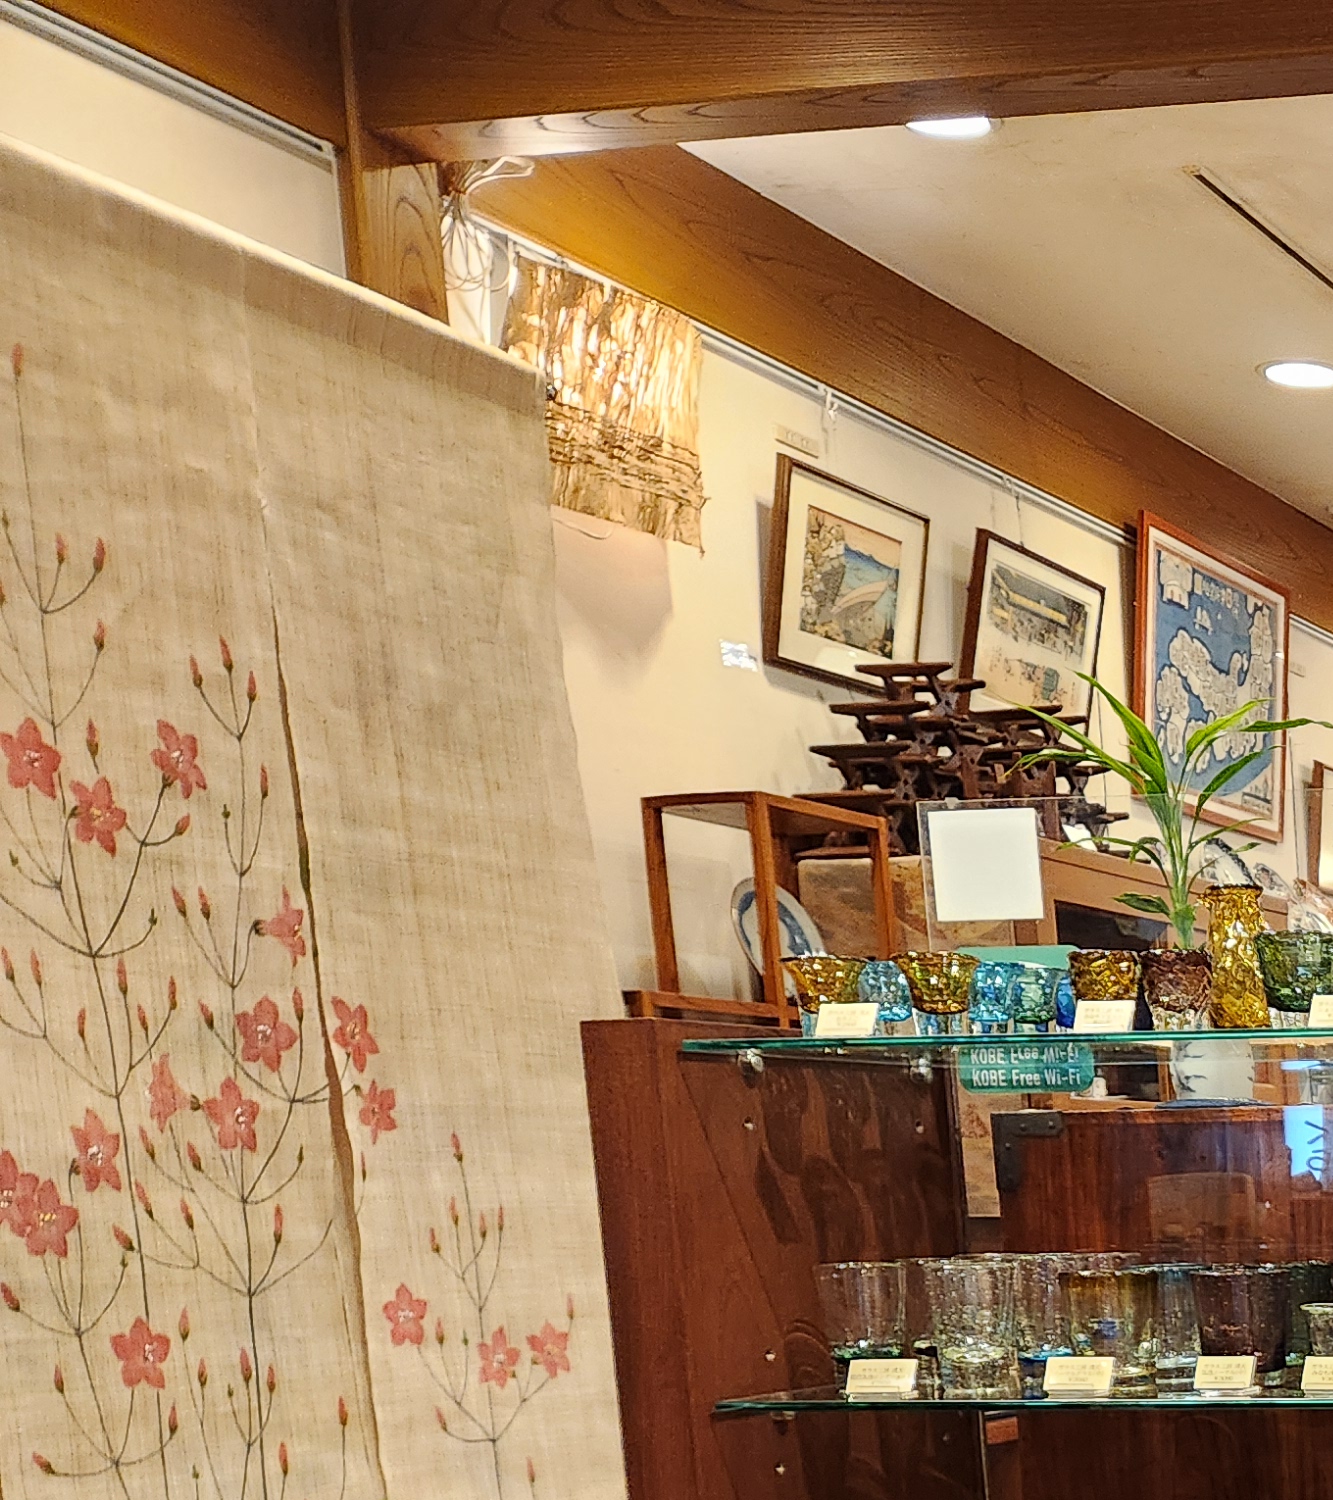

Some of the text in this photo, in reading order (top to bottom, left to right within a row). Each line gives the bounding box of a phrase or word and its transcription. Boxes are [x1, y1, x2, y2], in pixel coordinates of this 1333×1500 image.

[972, 1068, 1081, 1087] KOBE Free Wi-Fi
